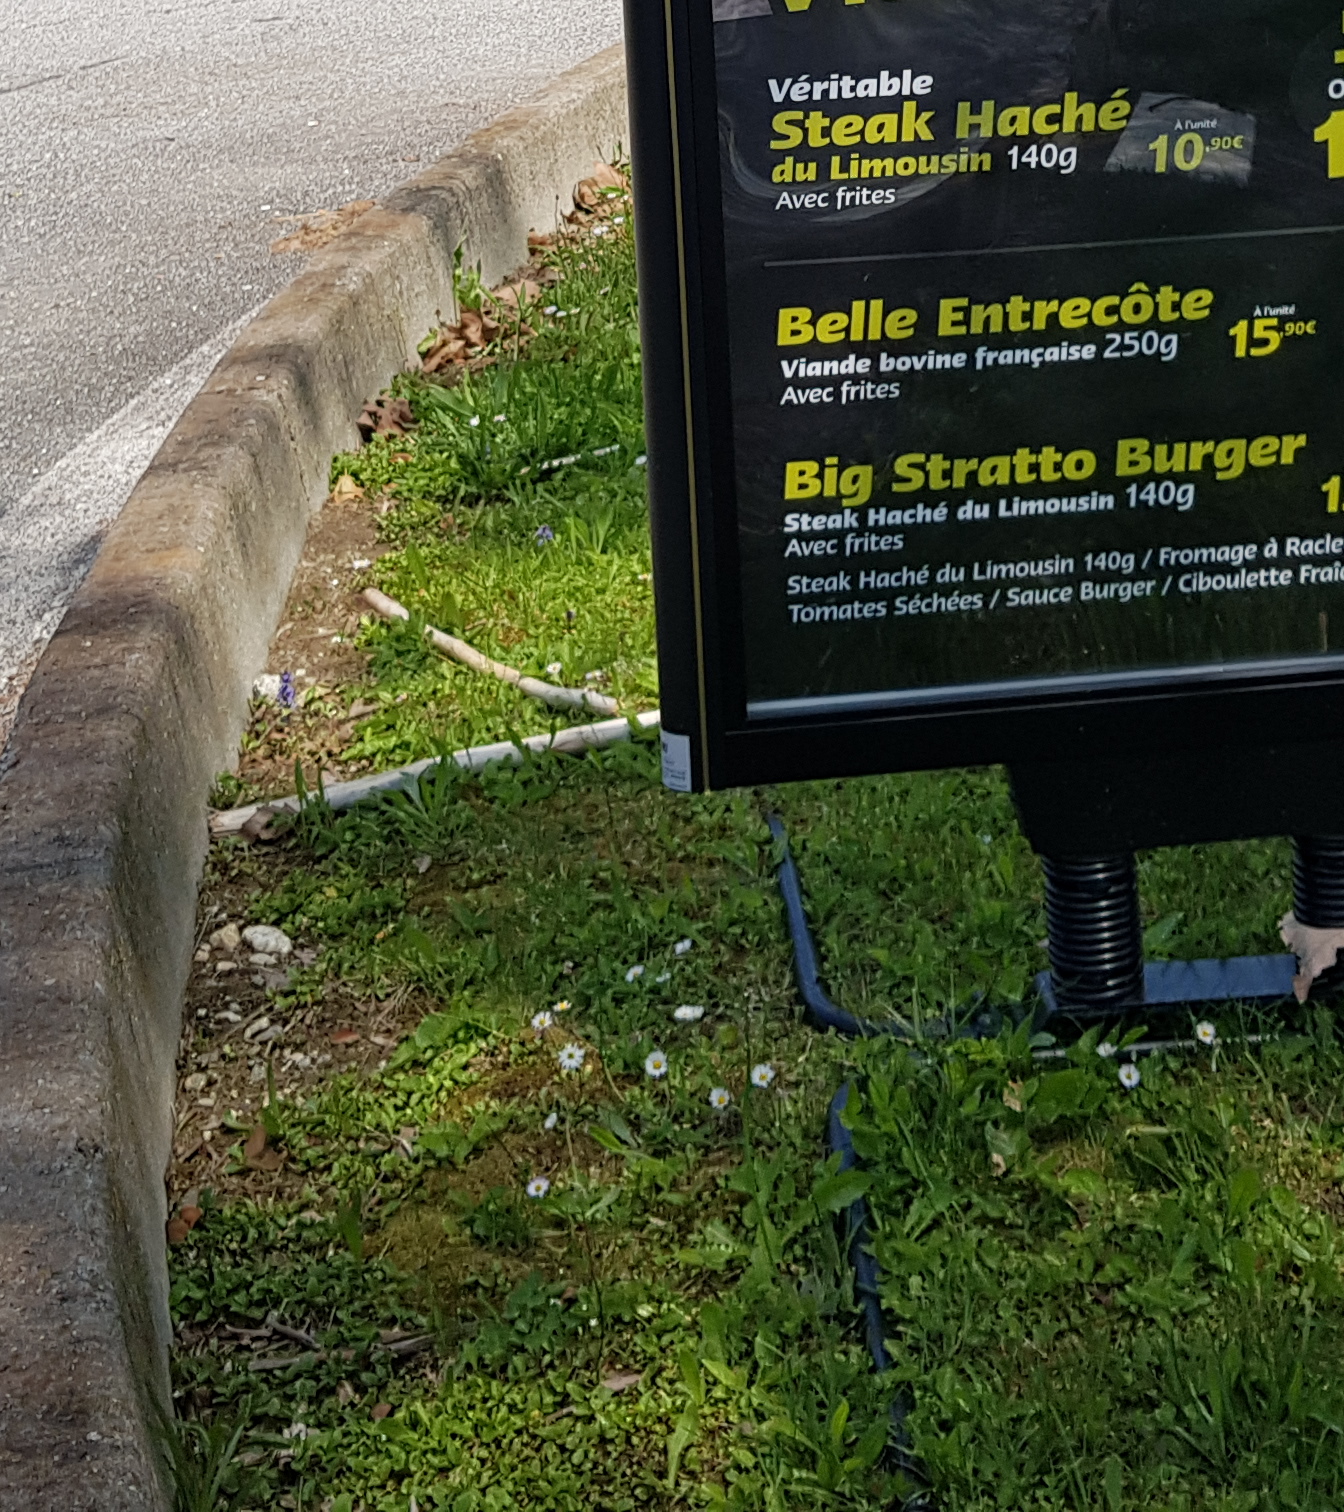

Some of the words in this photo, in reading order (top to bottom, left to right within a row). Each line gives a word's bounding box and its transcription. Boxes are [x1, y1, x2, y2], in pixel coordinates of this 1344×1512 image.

[767, 69, 934, 103] Véritable
[769, 100, 936, 150] Steak
[955, 87, 1131, 139] Haché
[771, 156, 817, 184] du
[829, 146, 991, 180] Limousin
[1007, 143, 1078, 175] 140g
[775, 190, 829, 211] Avec
[836, 186, 896, 210] frites
[776, 299, 918, 346] Belle
[937, 282, 1214, 337] Entrecôte
[780, 354, 871, 379] Viande
[879, 349, 967, 373] bovine
[975, 339, 1096, 371] française
[1102, 330, 1179, 362] 250g
[779, 384, 834, 406] Avec
[840, 379, 901, 405] frites
[784, 455, 874, 508] Big
[891, 445, 1097, 494] Stratto
[1115, 433, 1307, 481] Burger
[783, 508, 860, 534] Steak
[867, 500, 949, 528] Haché
[957, 499, 991, 522] du
[997, 491, 1115, 518] Limousin
[1125, 480, 1196, 512] 140g
[784, 538, 838, 559] Avec
[844, 532, 905, 557] frites
[787, 570, 852, 596] Steak
[858, 563, 930, 590] Haché
[935, 562, 965, 584] du
[972, 554, 1075, 581] Limousin
[1083, 550, 1136, 575] 140g
[1141, 548, 1153, 571] /
[1158, 543, 1258, 567] Fromage
[1263, 536, 1278, 559] à
[788, 599, 888, 624] Tomates
[893, 590, 984, 616] Séchées
[988, 588, 1001, 610] /
[1006, 587, 1073, 608] Sauce
[1079, 578, 1156, 604] Burger
[1160, 575, 1173, 597] /
[1178, 568, 1293, 595] Ciboulette
